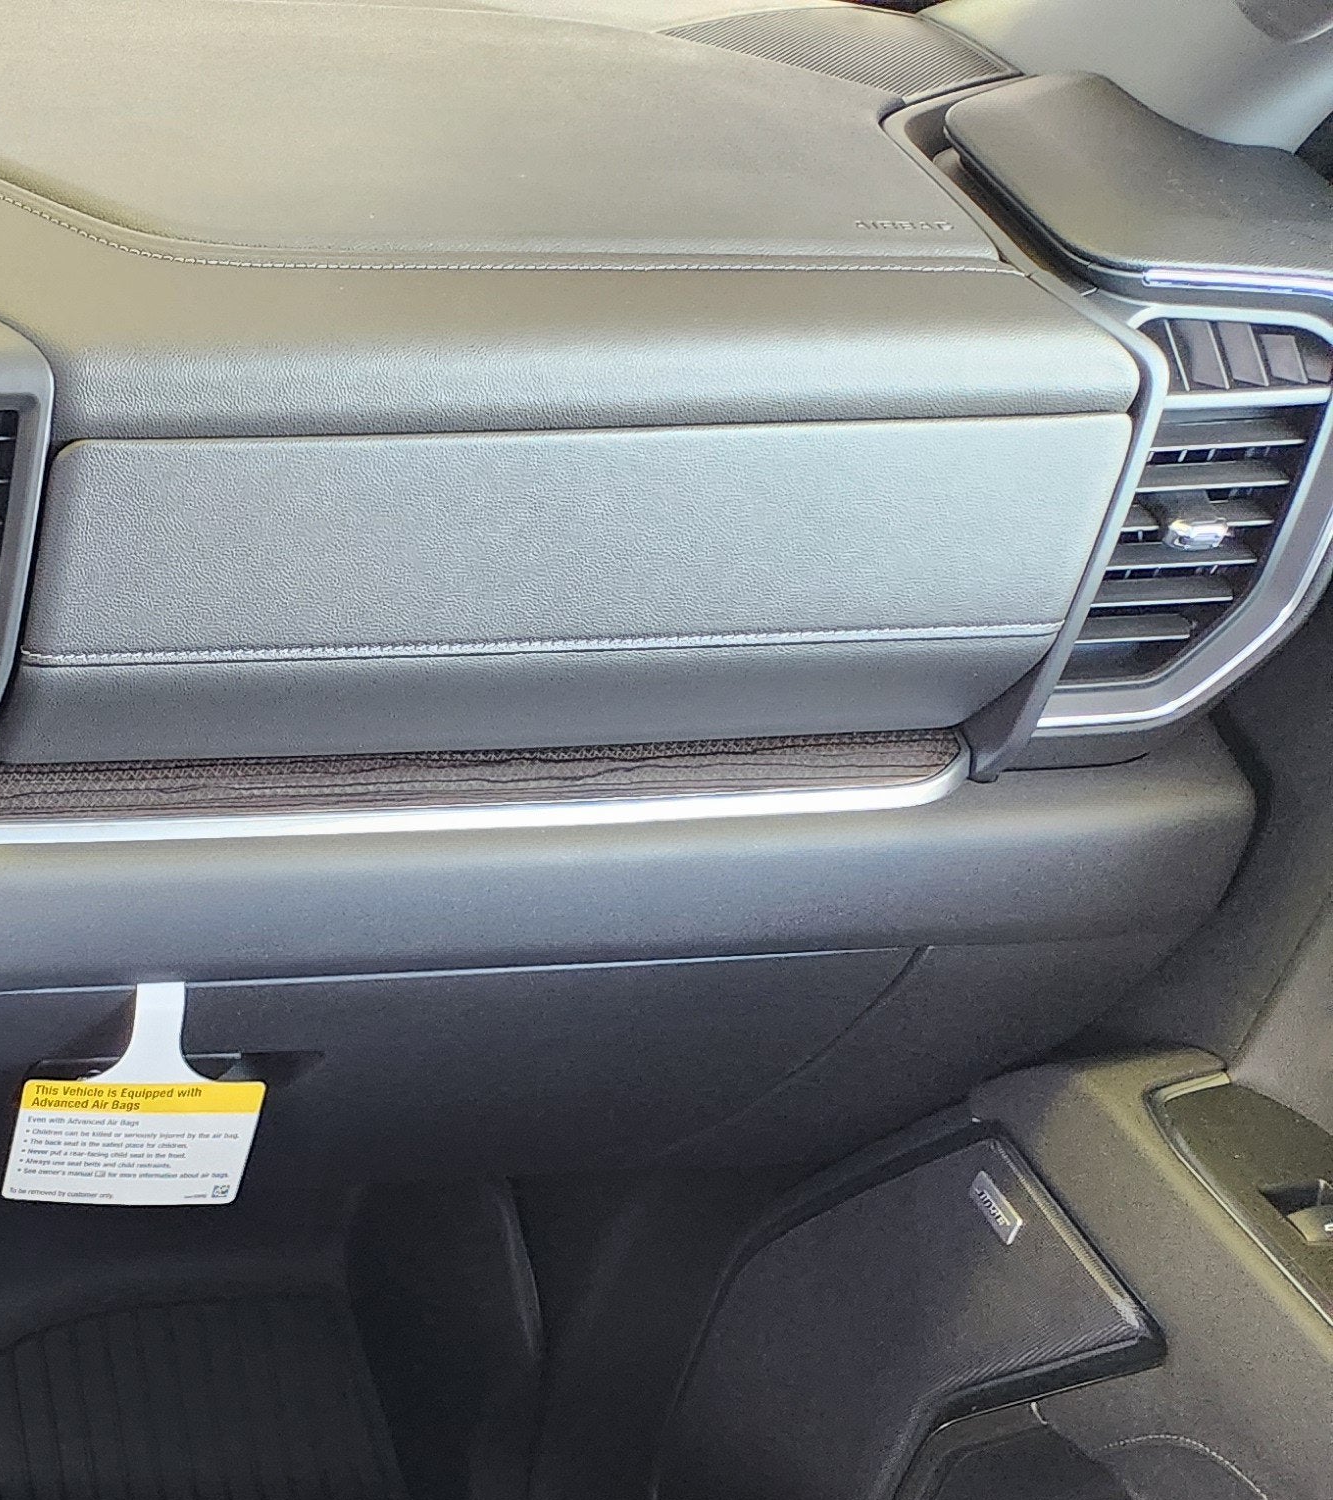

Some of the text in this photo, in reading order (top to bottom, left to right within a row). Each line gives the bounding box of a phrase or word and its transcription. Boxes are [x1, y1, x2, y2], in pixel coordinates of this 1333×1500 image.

[35, 1084, 202, 1100] This Vehicle is Equipped with
[31, 1097, 140, 1112] Advanced Air Bags
[27, 1115, 46, 1123] Even
[67, 1118, 105, 1126] Advanced
[119, 1119, 140, 1127] Bags
[32, 1128, 63, 1136] Children
[28, 1188, 57, 1196] removed
[67, 1190, 98, 1198] customer
